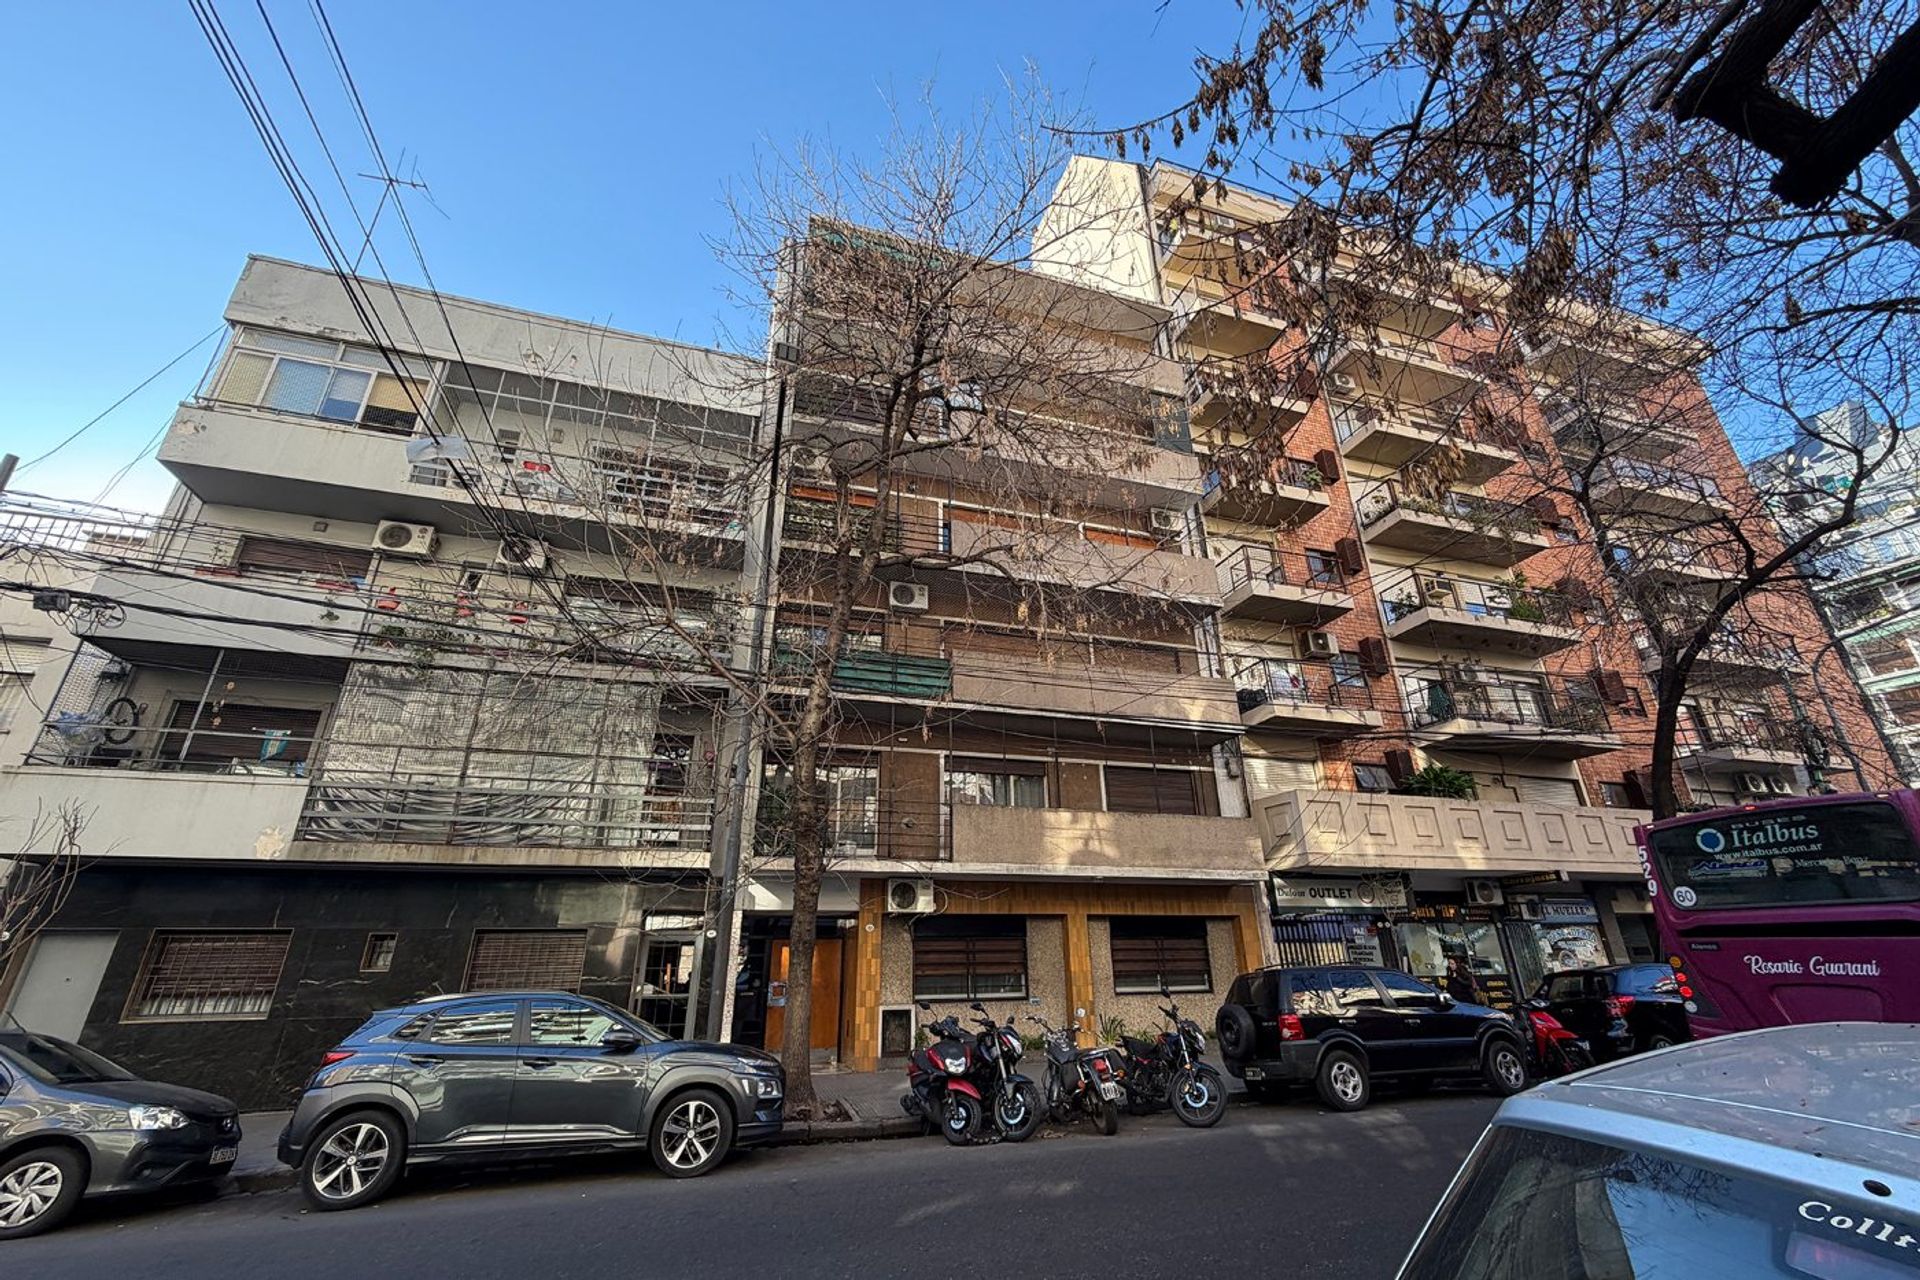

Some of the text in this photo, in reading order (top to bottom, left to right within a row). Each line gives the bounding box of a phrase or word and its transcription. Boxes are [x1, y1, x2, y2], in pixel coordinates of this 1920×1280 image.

[1732, 824, 1819, 848] Italbus
[1713, 842, 1823, 861] www.italbus.com.ar
[1308, 887, 1353, 899] OUTLET
[1676, 890, 1694, 904] 60
[1743, 955, 1804, 975] Rosario
